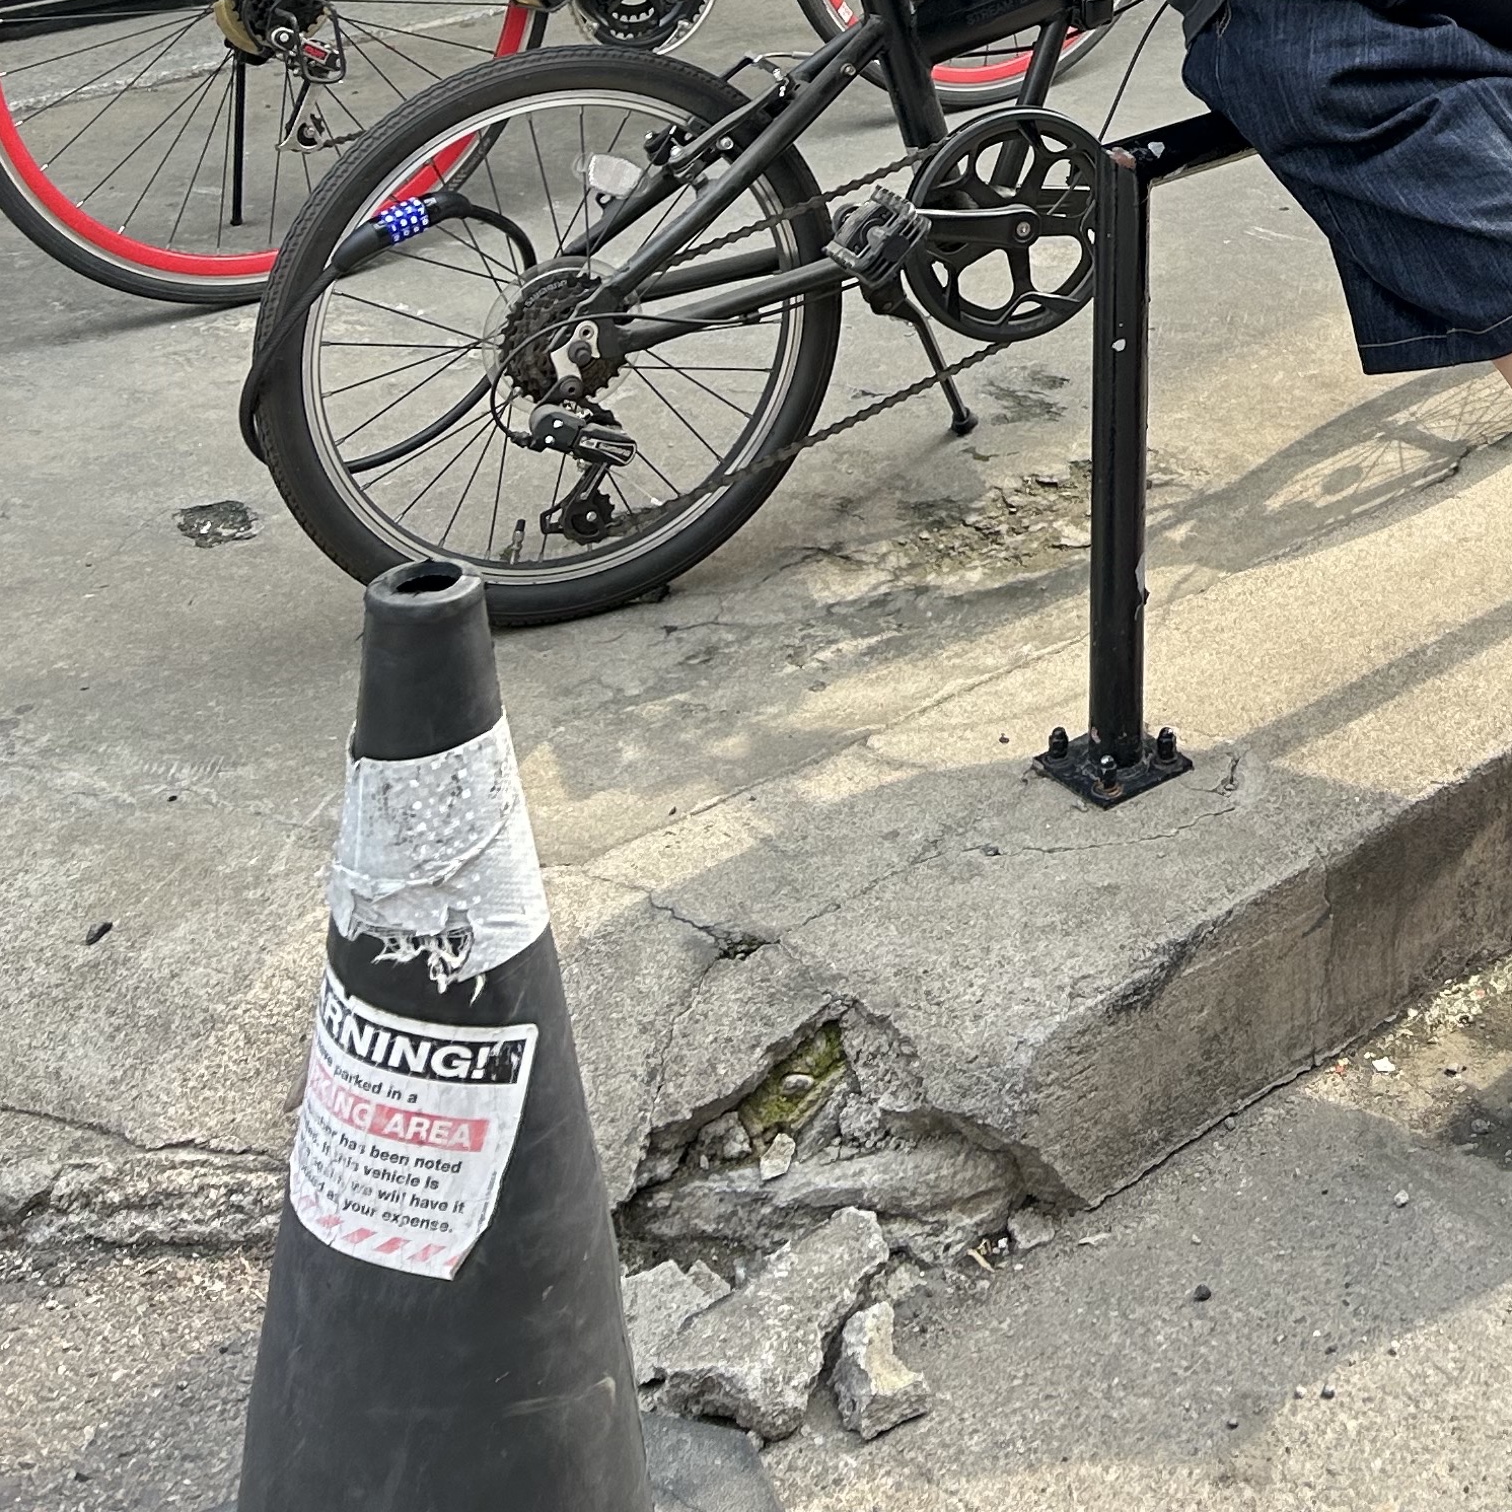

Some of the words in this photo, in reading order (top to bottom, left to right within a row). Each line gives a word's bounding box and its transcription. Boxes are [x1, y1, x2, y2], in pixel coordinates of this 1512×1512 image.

[320, 990, 491, 1080] RNING!
[333, 1065, 383, 1095] parked
[386, 1087, 402, 1100] in
[406, 1093, 418, 1104] a
[383, 1112, 472, 1148] AREA
[363, 1164, 421, 1189] vehicle
[369, 1145, 410, 1167] been
[414, 1156, 463, 1175] noted
[409, 1193, 448, 1212] have
[452, 1200, 466, 1215] it
